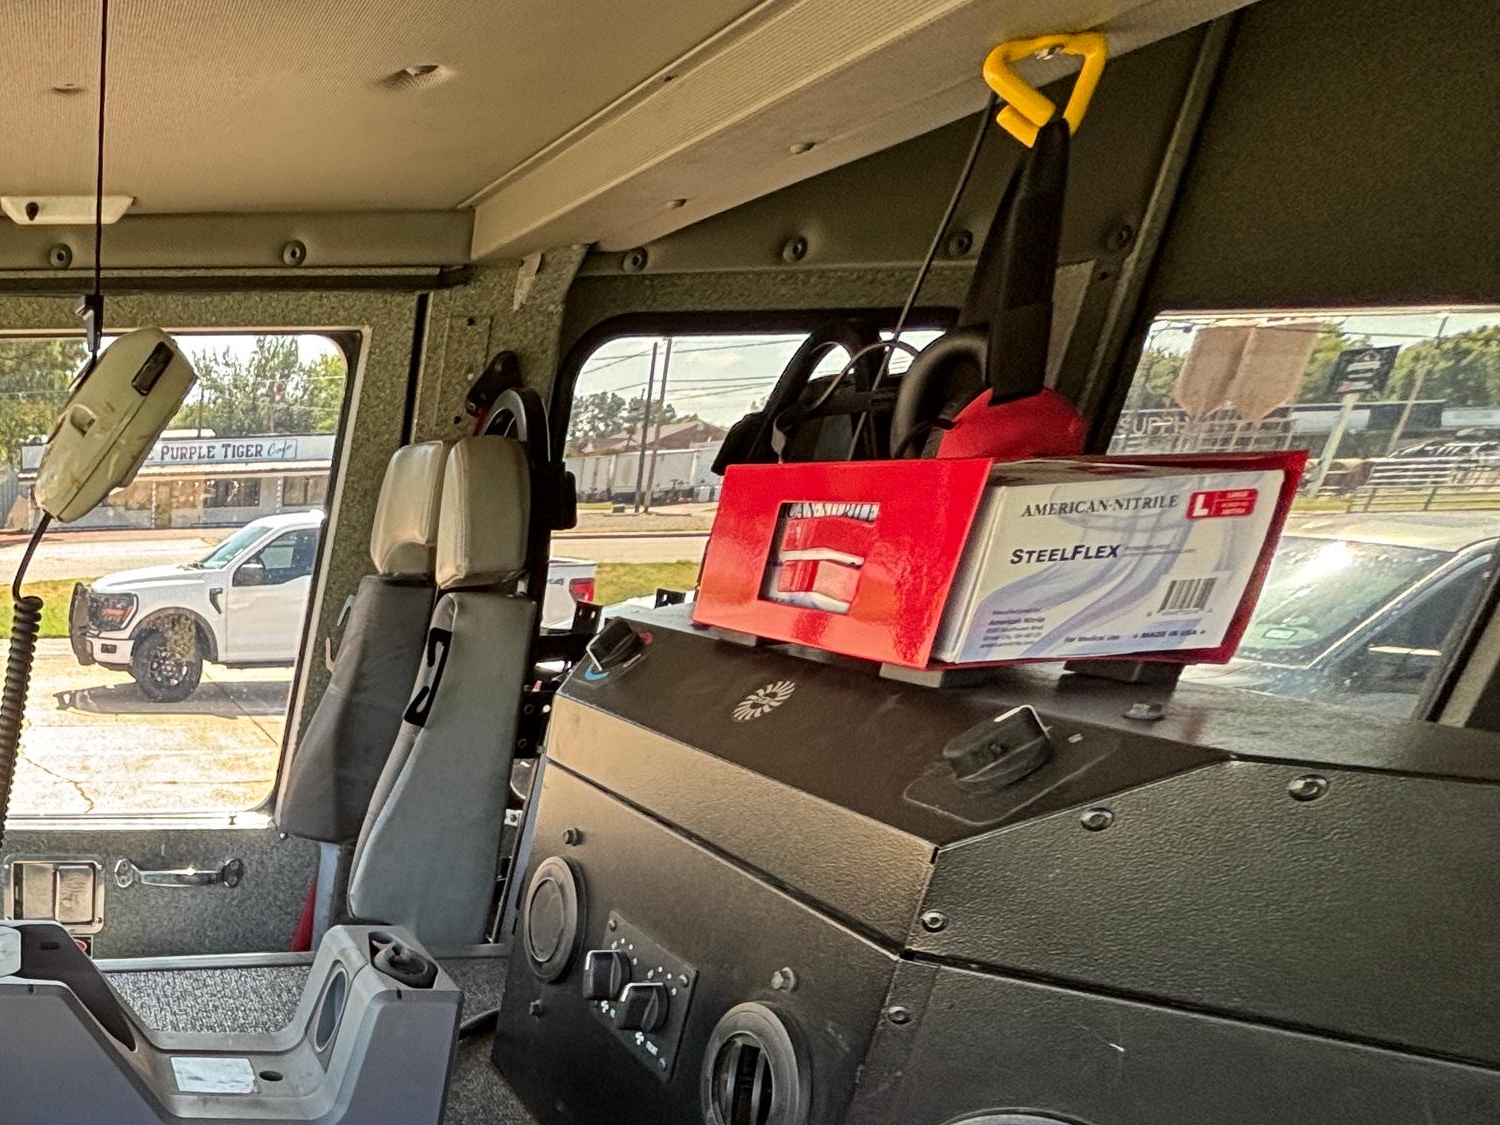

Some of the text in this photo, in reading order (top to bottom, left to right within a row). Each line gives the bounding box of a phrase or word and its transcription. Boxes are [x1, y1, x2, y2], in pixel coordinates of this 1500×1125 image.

[160, 445, 216, 461] PURPLE
[221, 443, 263, 459] TIGER
[1192, 494, 1209, 517] L
